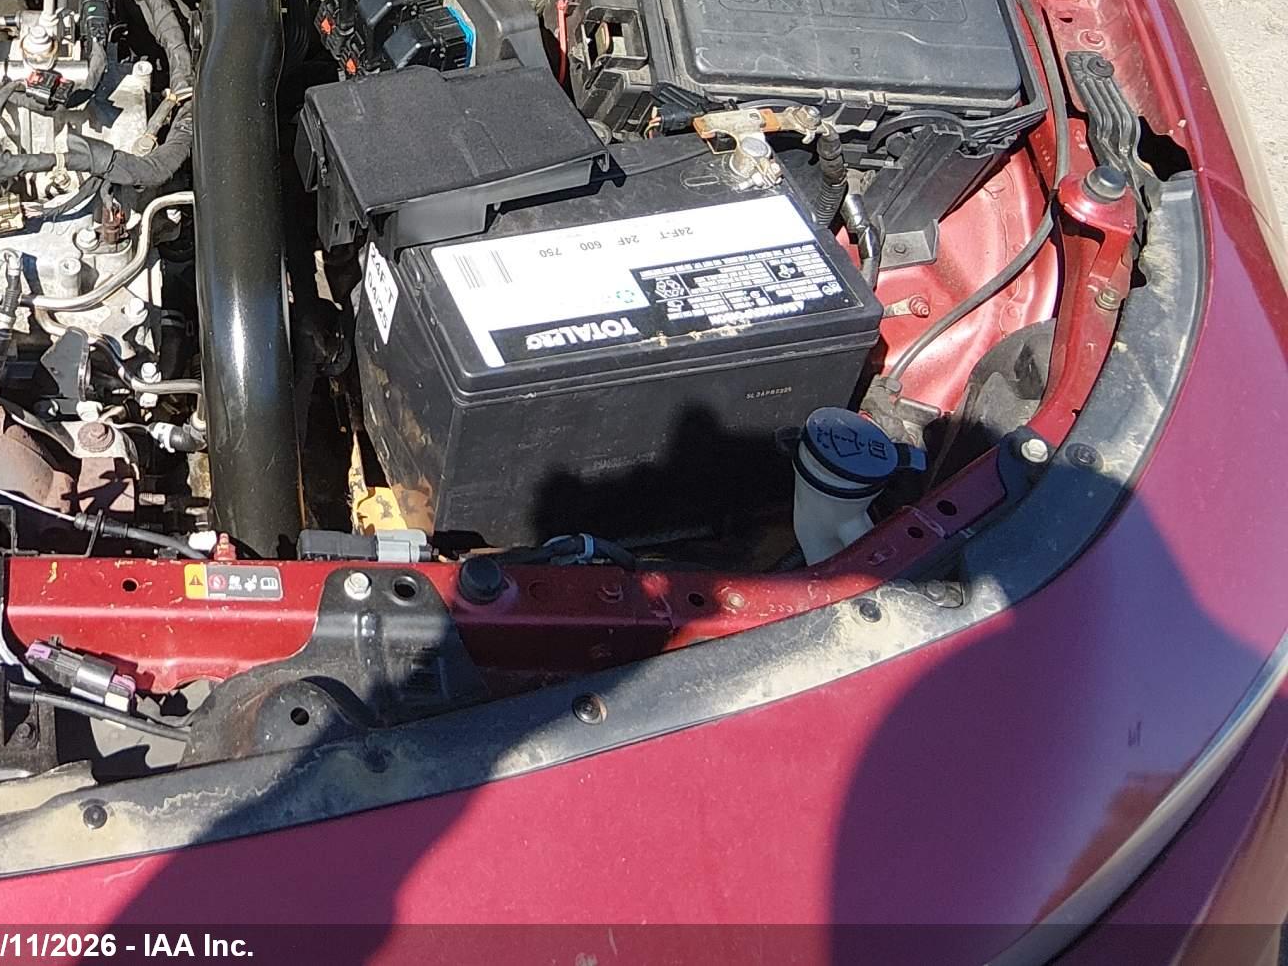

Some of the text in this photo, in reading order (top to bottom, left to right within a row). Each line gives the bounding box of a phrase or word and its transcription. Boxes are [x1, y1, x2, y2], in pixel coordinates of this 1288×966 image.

[539, 226, 694, 258] 24F-T 24F 600 750
